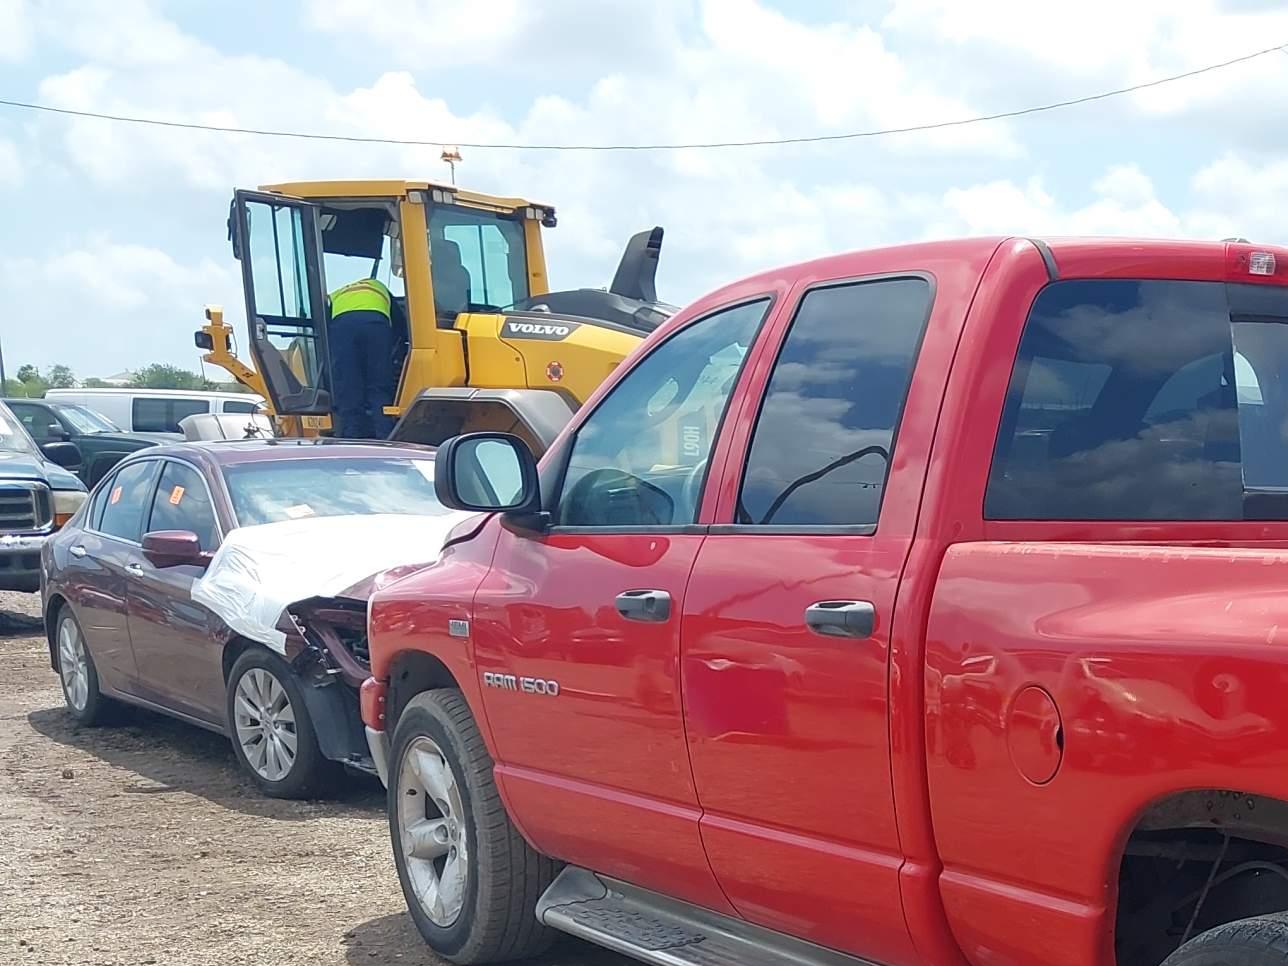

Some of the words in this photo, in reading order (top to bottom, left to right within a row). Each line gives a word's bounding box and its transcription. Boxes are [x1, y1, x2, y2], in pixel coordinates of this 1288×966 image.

[509, 322, 569, 335] VOLVO
[683, 426, 700, 456] L90H
[484, 671, 517, 691] RAM
[518, 676, 560, 696] 1500
